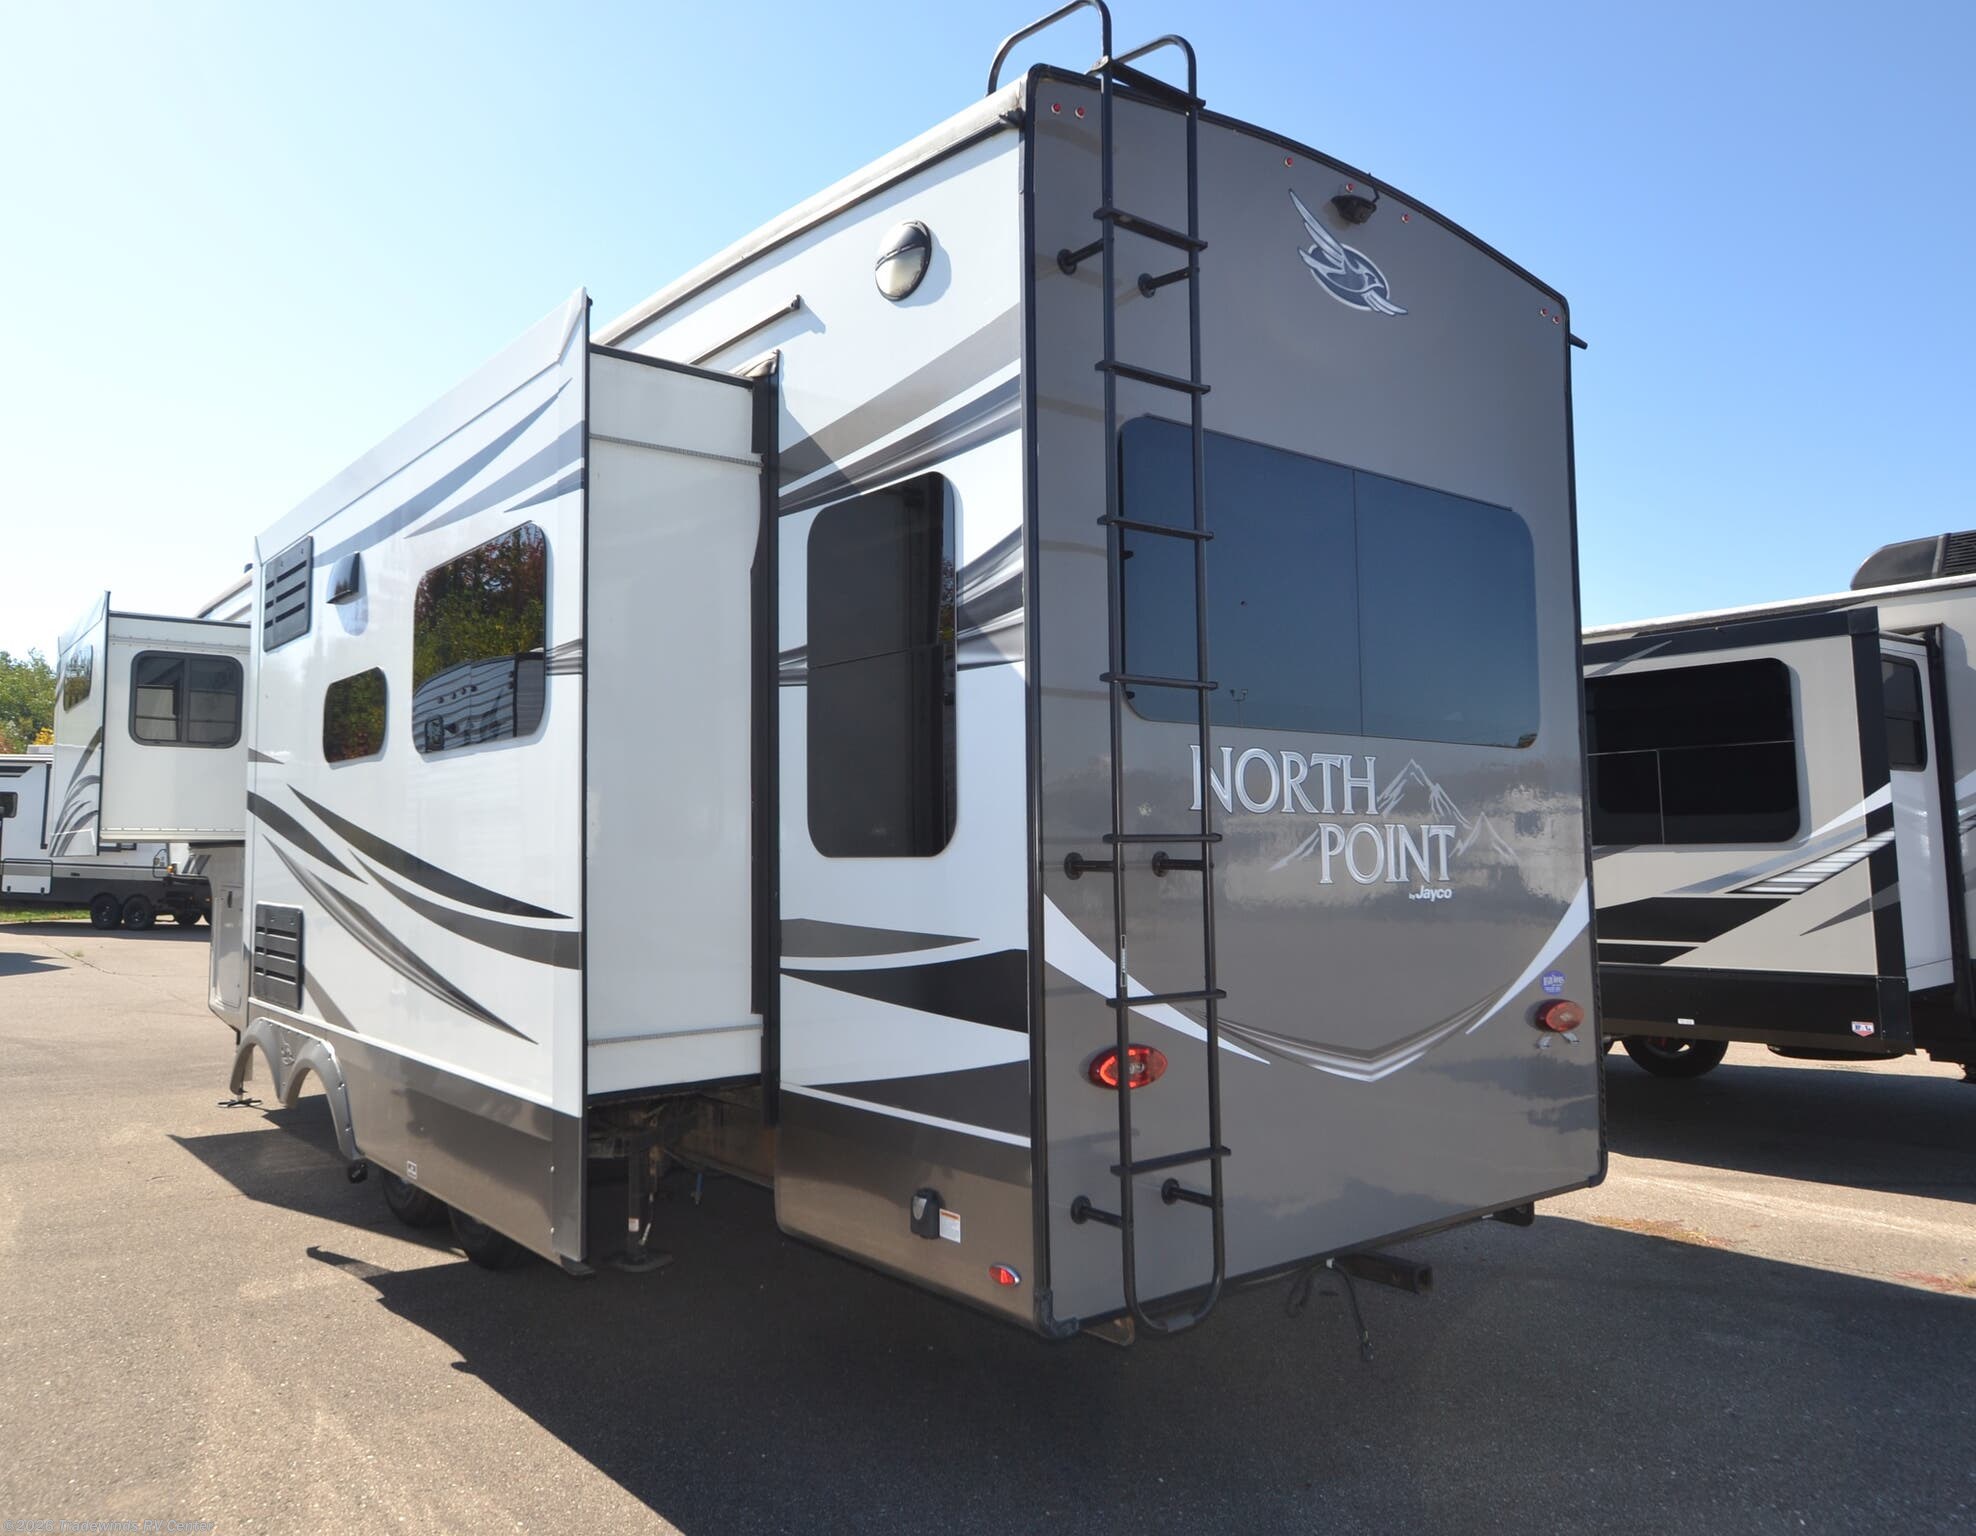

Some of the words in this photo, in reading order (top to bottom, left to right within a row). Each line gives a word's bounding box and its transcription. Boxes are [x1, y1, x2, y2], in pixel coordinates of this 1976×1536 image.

[1189, 745, 1379, 815] NORTH
[1319, 823, 1456, 884] POINT
[1415, 885, 1453, 902] Jayco
